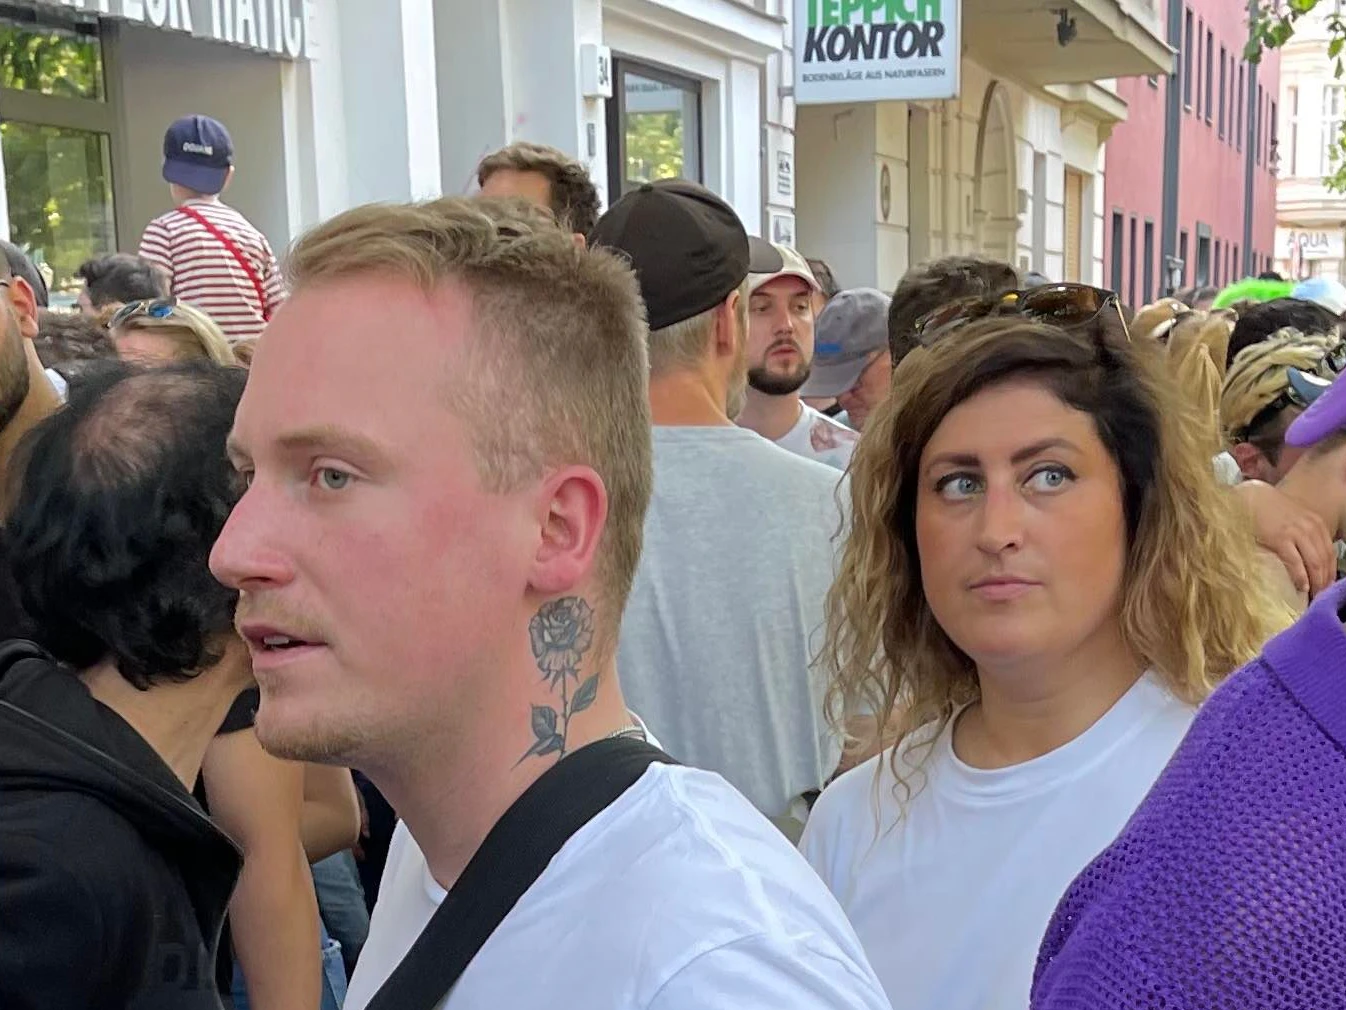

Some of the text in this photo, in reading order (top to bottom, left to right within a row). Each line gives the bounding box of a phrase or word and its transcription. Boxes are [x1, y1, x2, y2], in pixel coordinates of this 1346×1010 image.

[803, 20, 945, 63] KONTOR
[865, 70, 882, 80] AUS
[1286, 230, 1329, 248] AQUA
